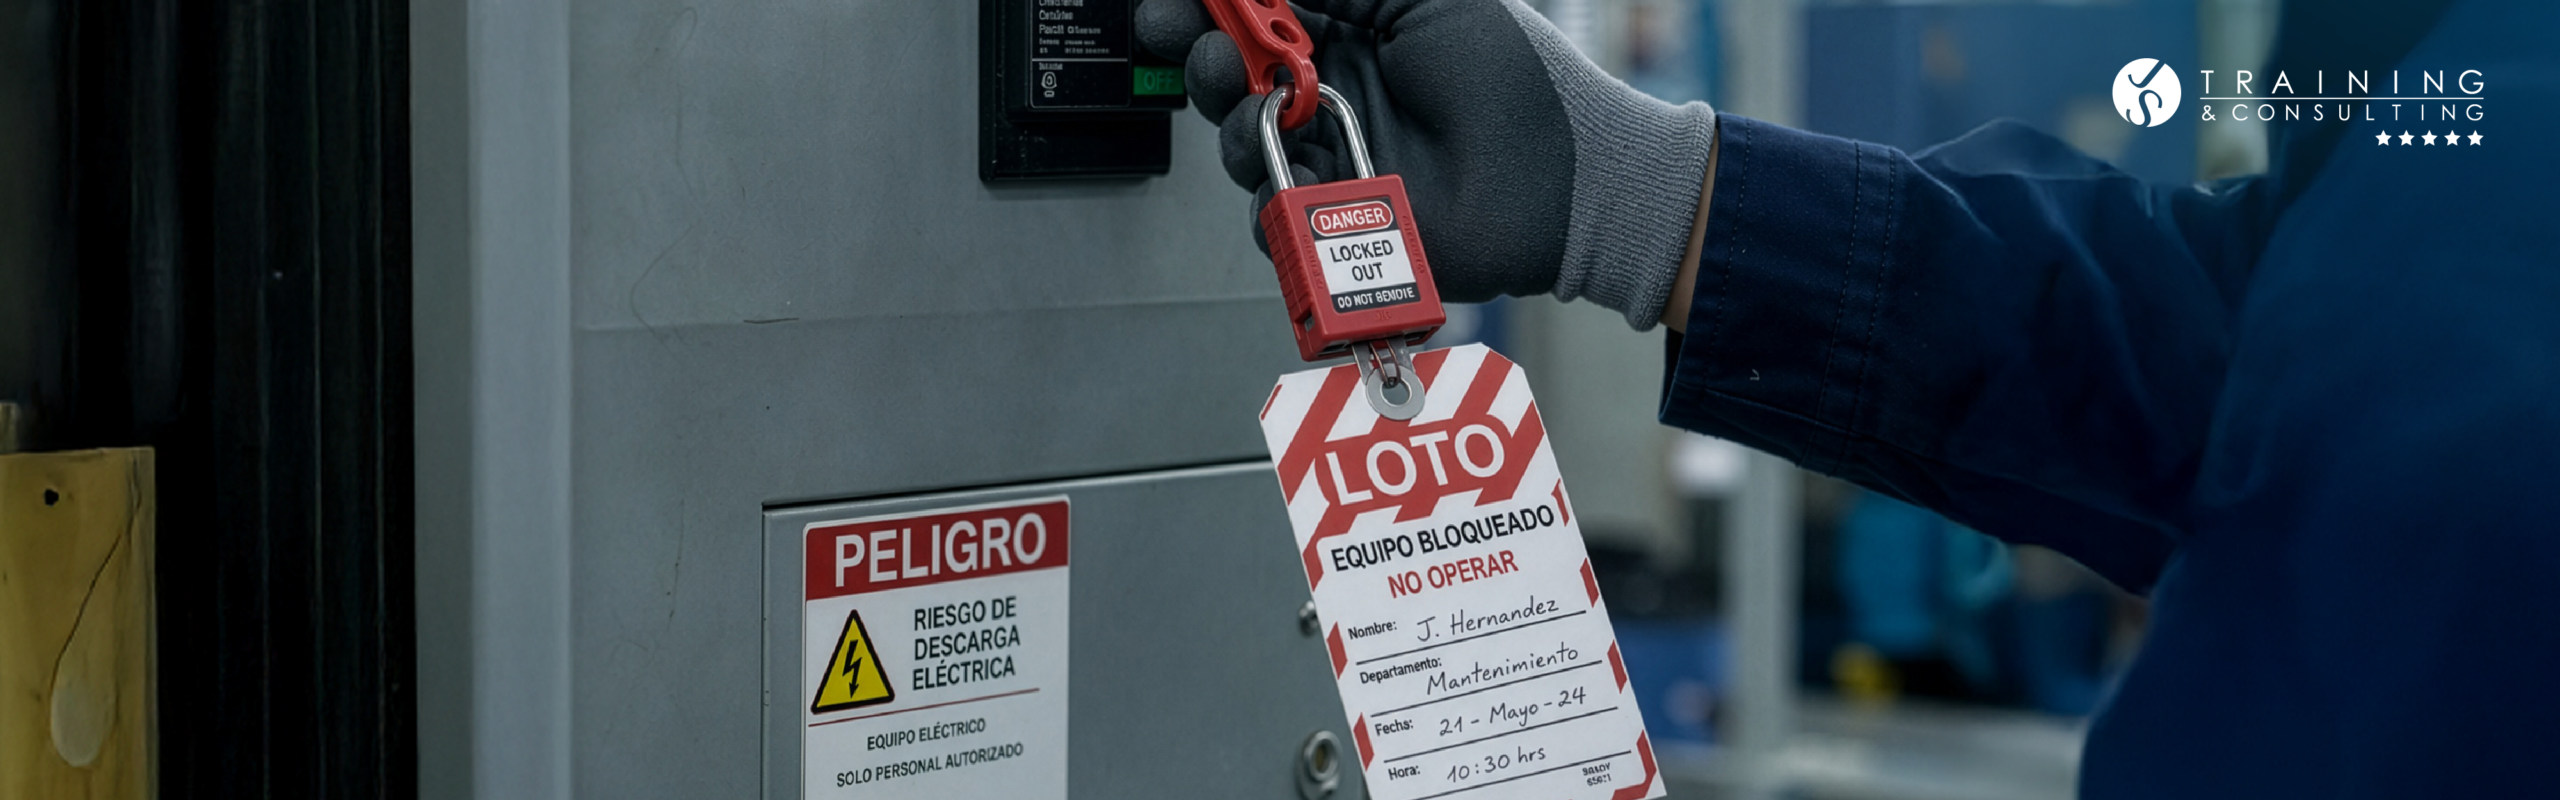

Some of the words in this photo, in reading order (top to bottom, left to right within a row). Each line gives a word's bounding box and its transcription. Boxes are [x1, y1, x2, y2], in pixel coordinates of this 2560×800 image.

[1143, 71, 1175, 91] OFF
[1319, 207, 1387, 231] DANGER
[1329, 239, 1394, 263] LOCKED
[1351, 262, 1384, 282] OUT
[1354, 292, 1373, 306] NOT
[1325, 424, 1505, 506] LOTO
[835, 512, 1046, 588] PELIGRO
[1331, 534, 1414, 572] EQUIPO
[1417, 504, 1555, 554] BLOQUEADO
[1387, 571, 1423, 599] NO
[1427, 549, 1519, 589] OPERAR
[914, 600, 986, 631] RIESGO
[991, 596, 1017, 620] DE
[1347, 620, 1398, 640] Nombre:
[1416, 615, 1440, 642] J.
[1450, 595, 1560, 636] Hernandez
[914, 625, 1021, 661] DESCARGA
[912, 655, 1016, 691] ELÉCTRICA
[1360, 657, 1443, 685] Departamento:
[1426, 641, 1579, 696] Mantenimiento
[1439, 716, 1464, 736] 21
[1489, 703, 1539, 727] Mayo
[1558, 686, 1586, 708] 24
[866, 729, 916, 751] EQUIPO
[919, 717, 986, 742] ELÉCTRICO
[836, 768, 872, 788] SOLO
[876, 758, 942, 782] PERSONAL
[945, 742, 1024, 769] AUTORIZADO
[1388, 764, 1421, 781] Hora:
[1517, 746, 1546, 764] hrs
